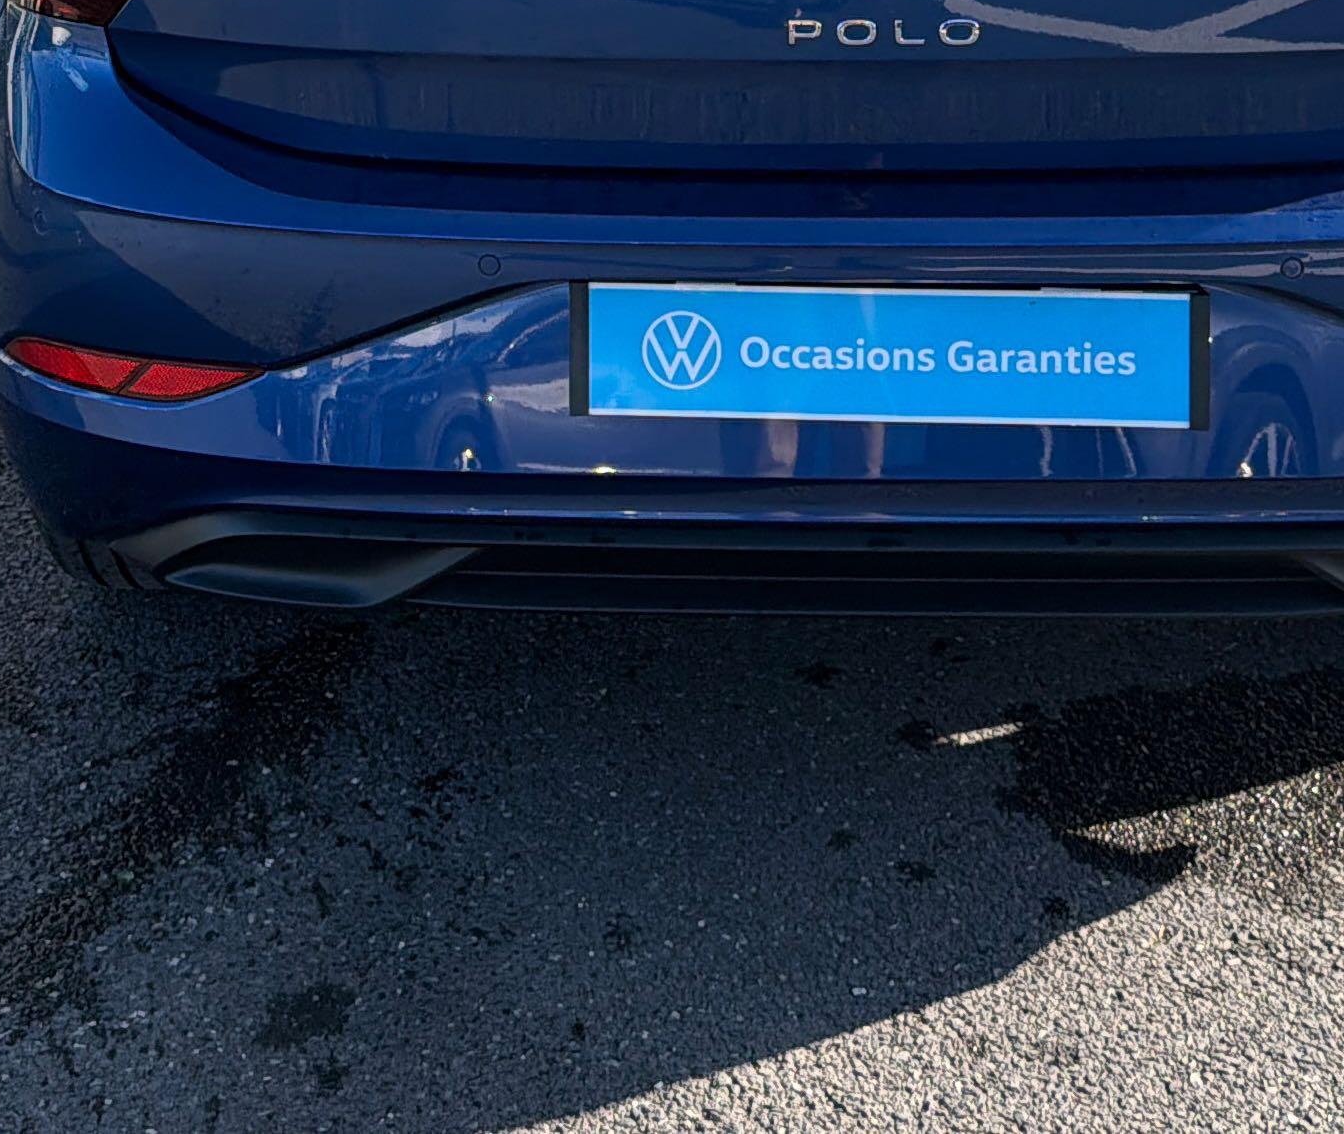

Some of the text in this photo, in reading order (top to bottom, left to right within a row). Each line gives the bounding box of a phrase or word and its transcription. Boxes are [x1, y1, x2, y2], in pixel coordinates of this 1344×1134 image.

[788, 19, 980, 45] POLO
[740, 336, 935, 372] Occasions
[947, 341, 1136, 375] Garanties
